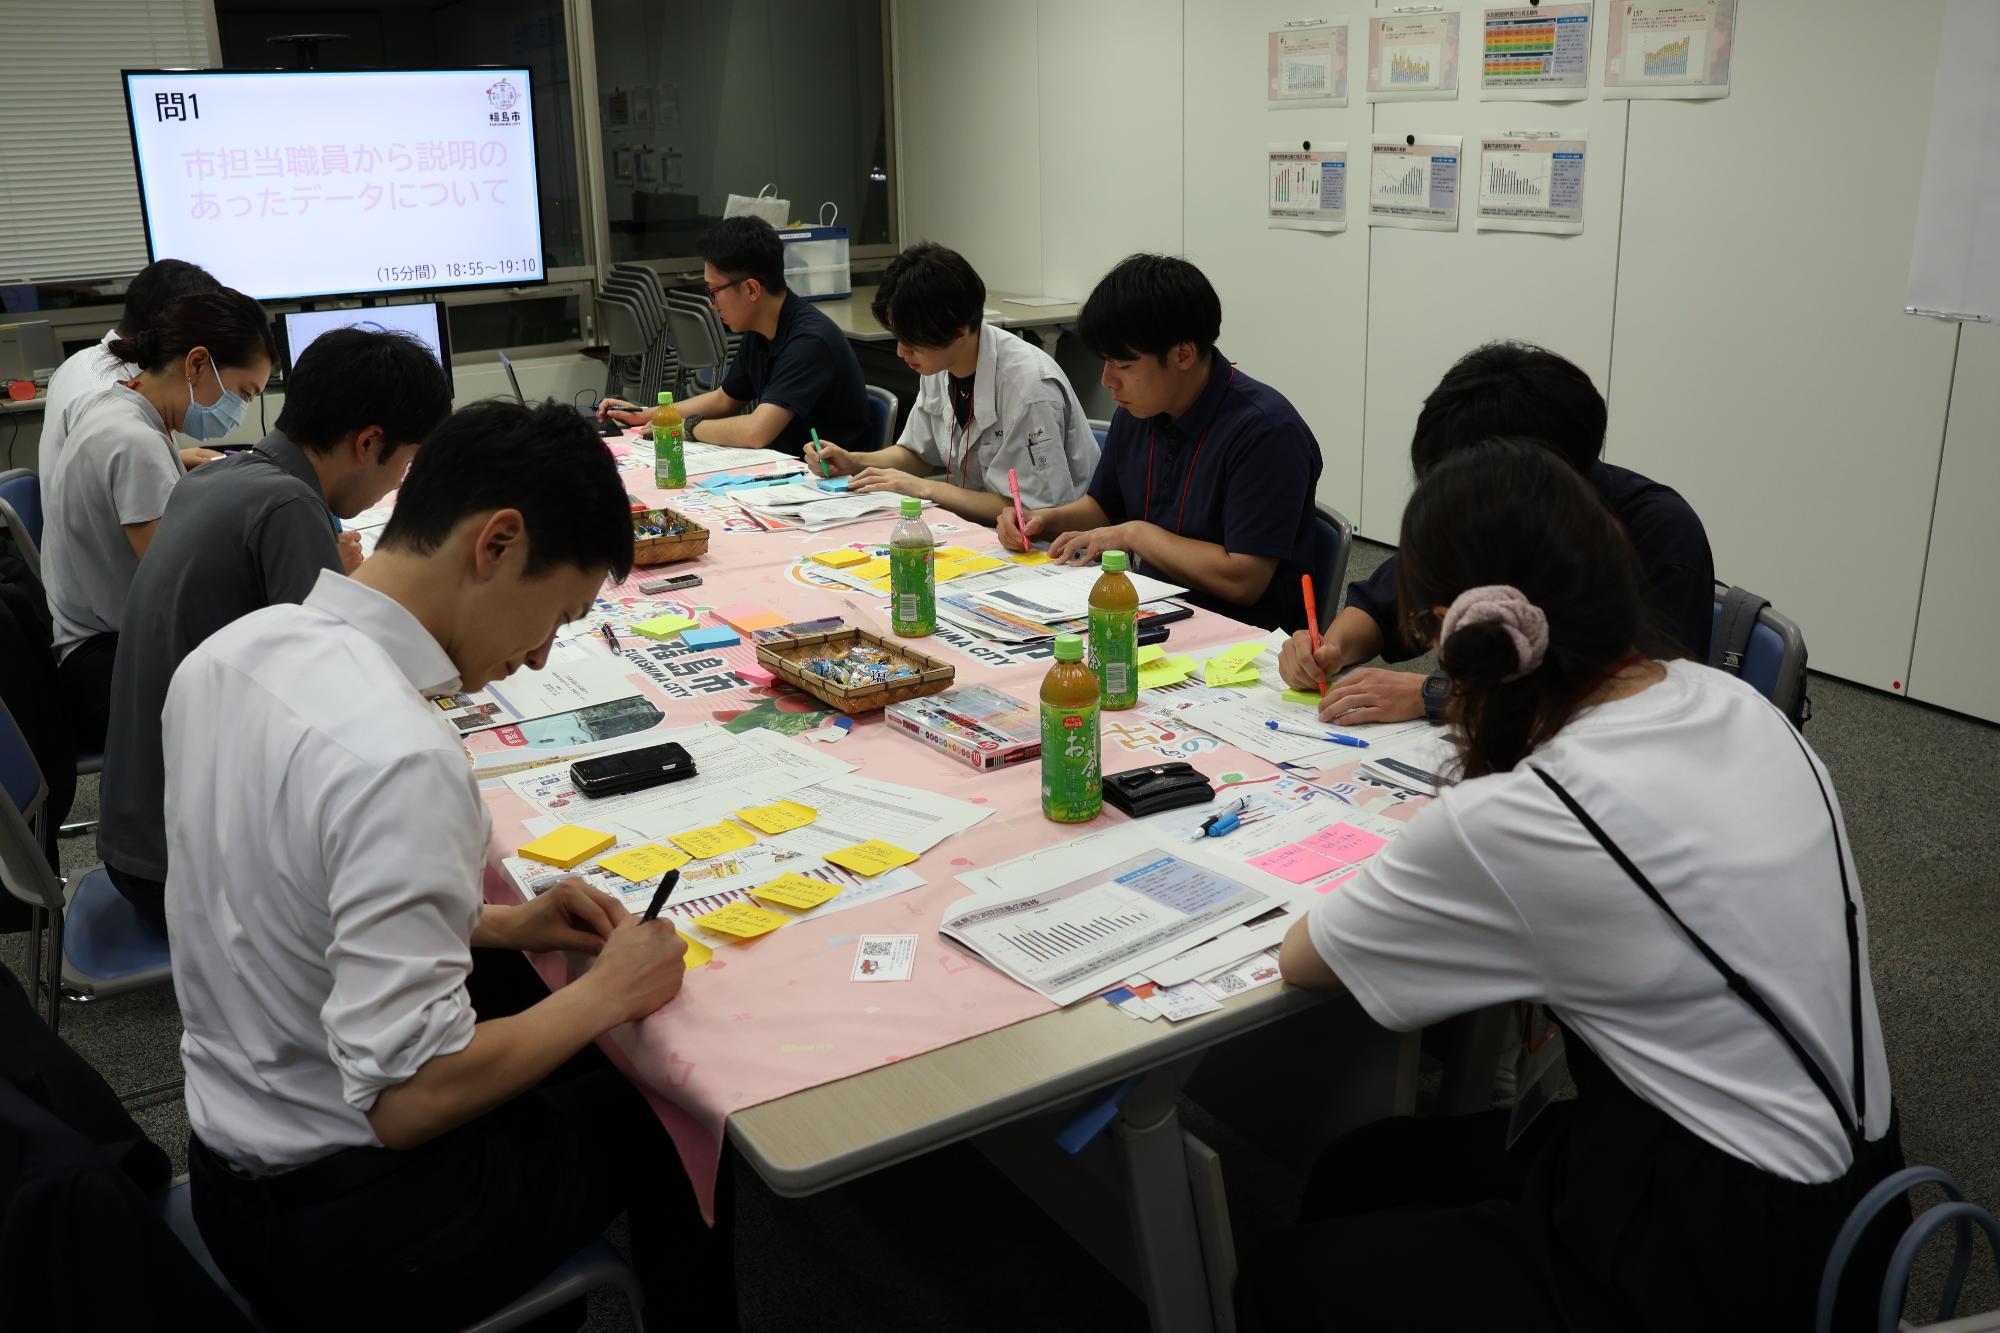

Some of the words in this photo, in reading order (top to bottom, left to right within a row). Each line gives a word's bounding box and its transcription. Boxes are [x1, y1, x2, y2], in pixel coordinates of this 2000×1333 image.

[155, 92, 199, 122] 問1
[489, 111, 520, 122] 福島市
[182, 140, 508, 181] 市担当職員から説明の
[190, 179, 509, 220] あったデータについて
[969, 647, 1016, 665] CITY
[663, 682, 693, 698] CITY
[972, 752, 981, 765] 10
